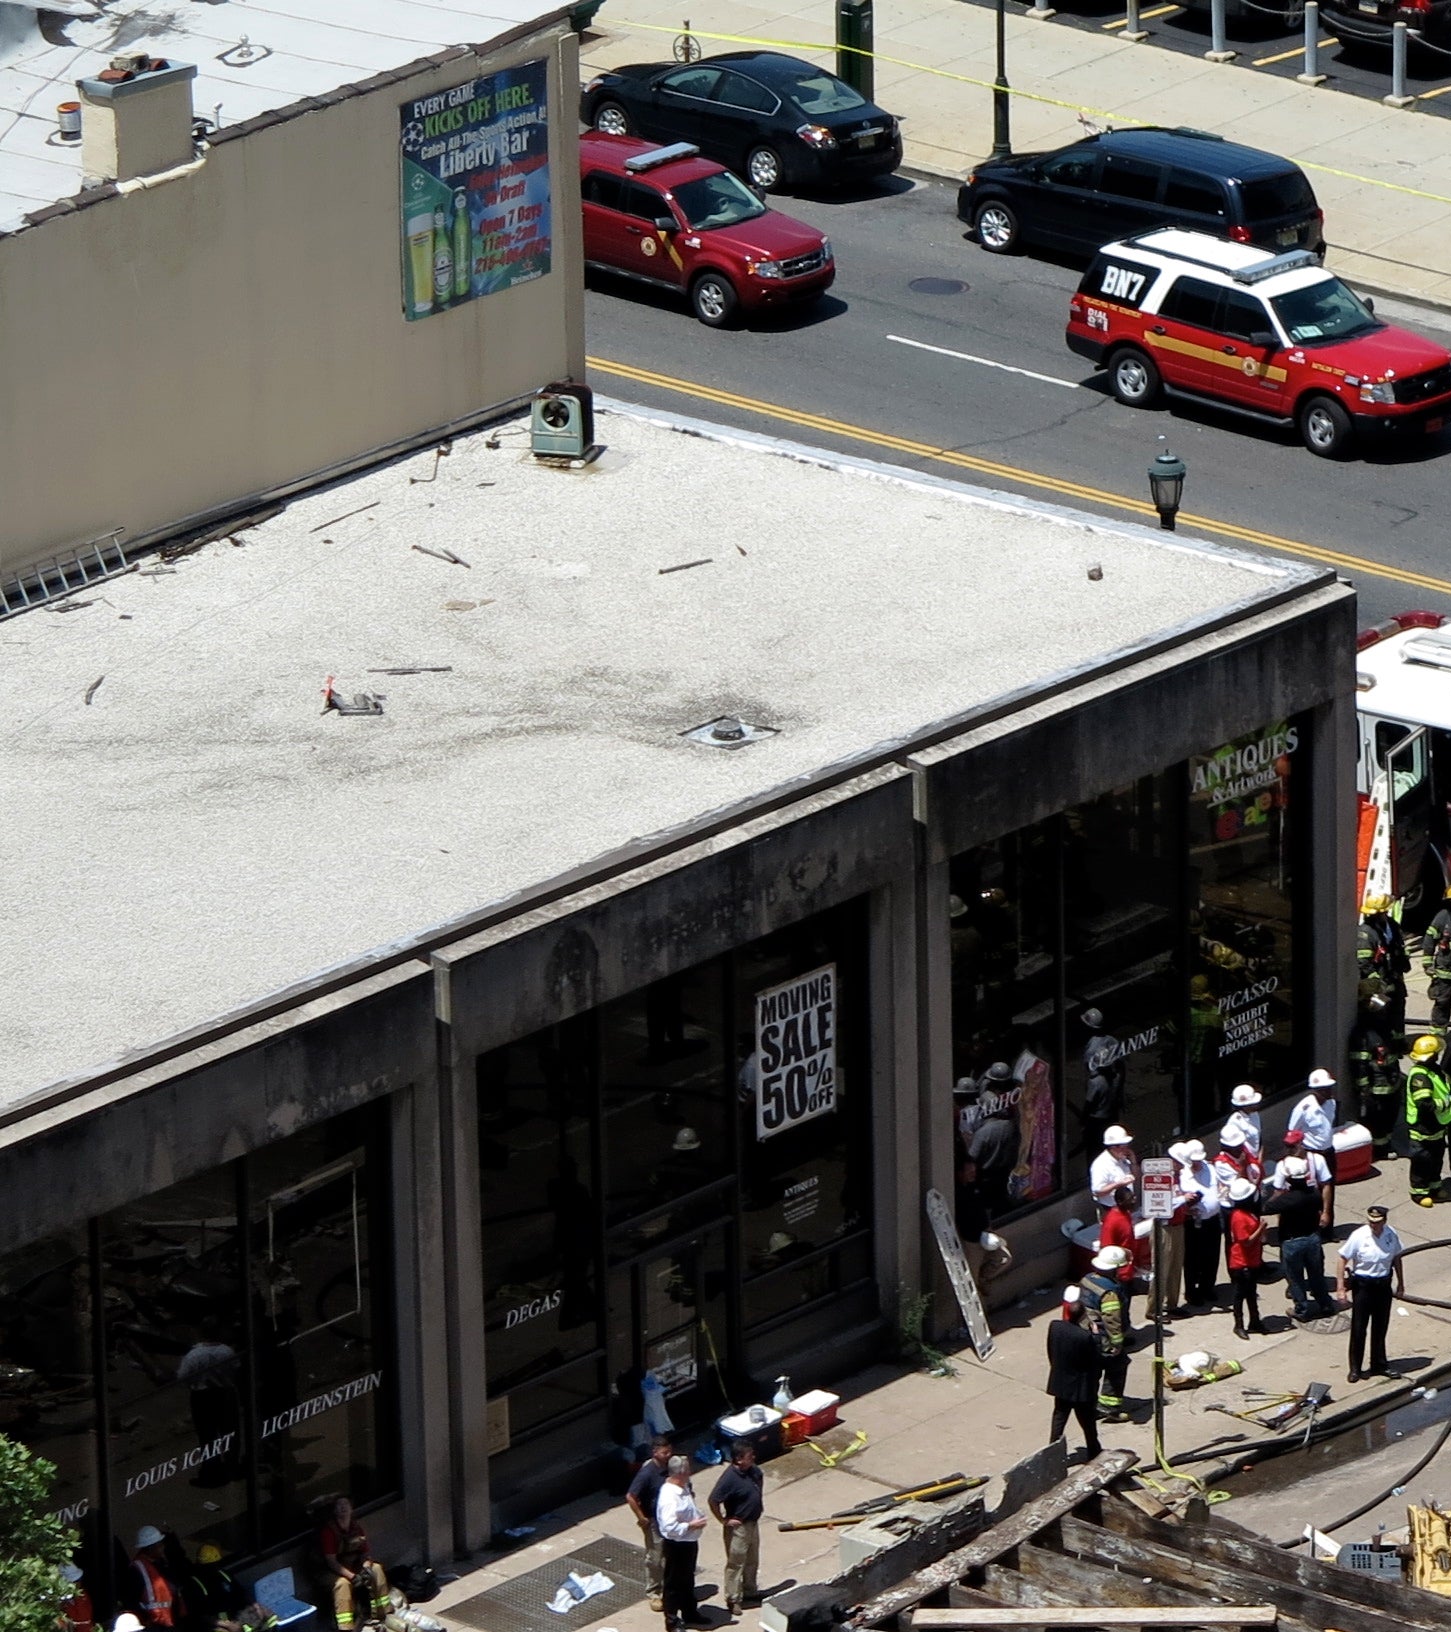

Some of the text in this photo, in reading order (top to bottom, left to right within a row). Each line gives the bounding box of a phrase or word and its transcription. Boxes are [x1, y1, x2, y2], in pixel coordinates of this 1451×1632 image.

[414, 79, 475, 118] EVERY GAME
[425, 83, 534, 138] KICKS OFF HERE.
[421, 141, 446, 160] Catch
[507, 112, 536, 132] Action
[440, 141, 495, 178] Liberty
[500, 130, 529, 157] Bar
[1101, 265, 1146, 301] BN7
[1192, 727, 1299, 793] ANTIQUES
[1212, 764, 1277, 804] & Artwork
[761, 973, 831, 1026] MOVING
[1218, 976, 1278, 1015] PICASSO
[1223, 1002, 1270, 1031] EXHIBIT
[761, 1002, 832, 1074] SALE
[1218, 1024, 1274, 1058] PROGRESS
[1226, 1016, 1267, 1042] NOW IN
[763, 1053, 832, 1129] 50%
[808, 1085, 834, 1113] OFF
[505, 1290, 561, 1330] DEGAS
[261, 1371, 383, 1440] LICHTENSTEIN
[125, 1432, 236, 1498] LOUIS ICART
